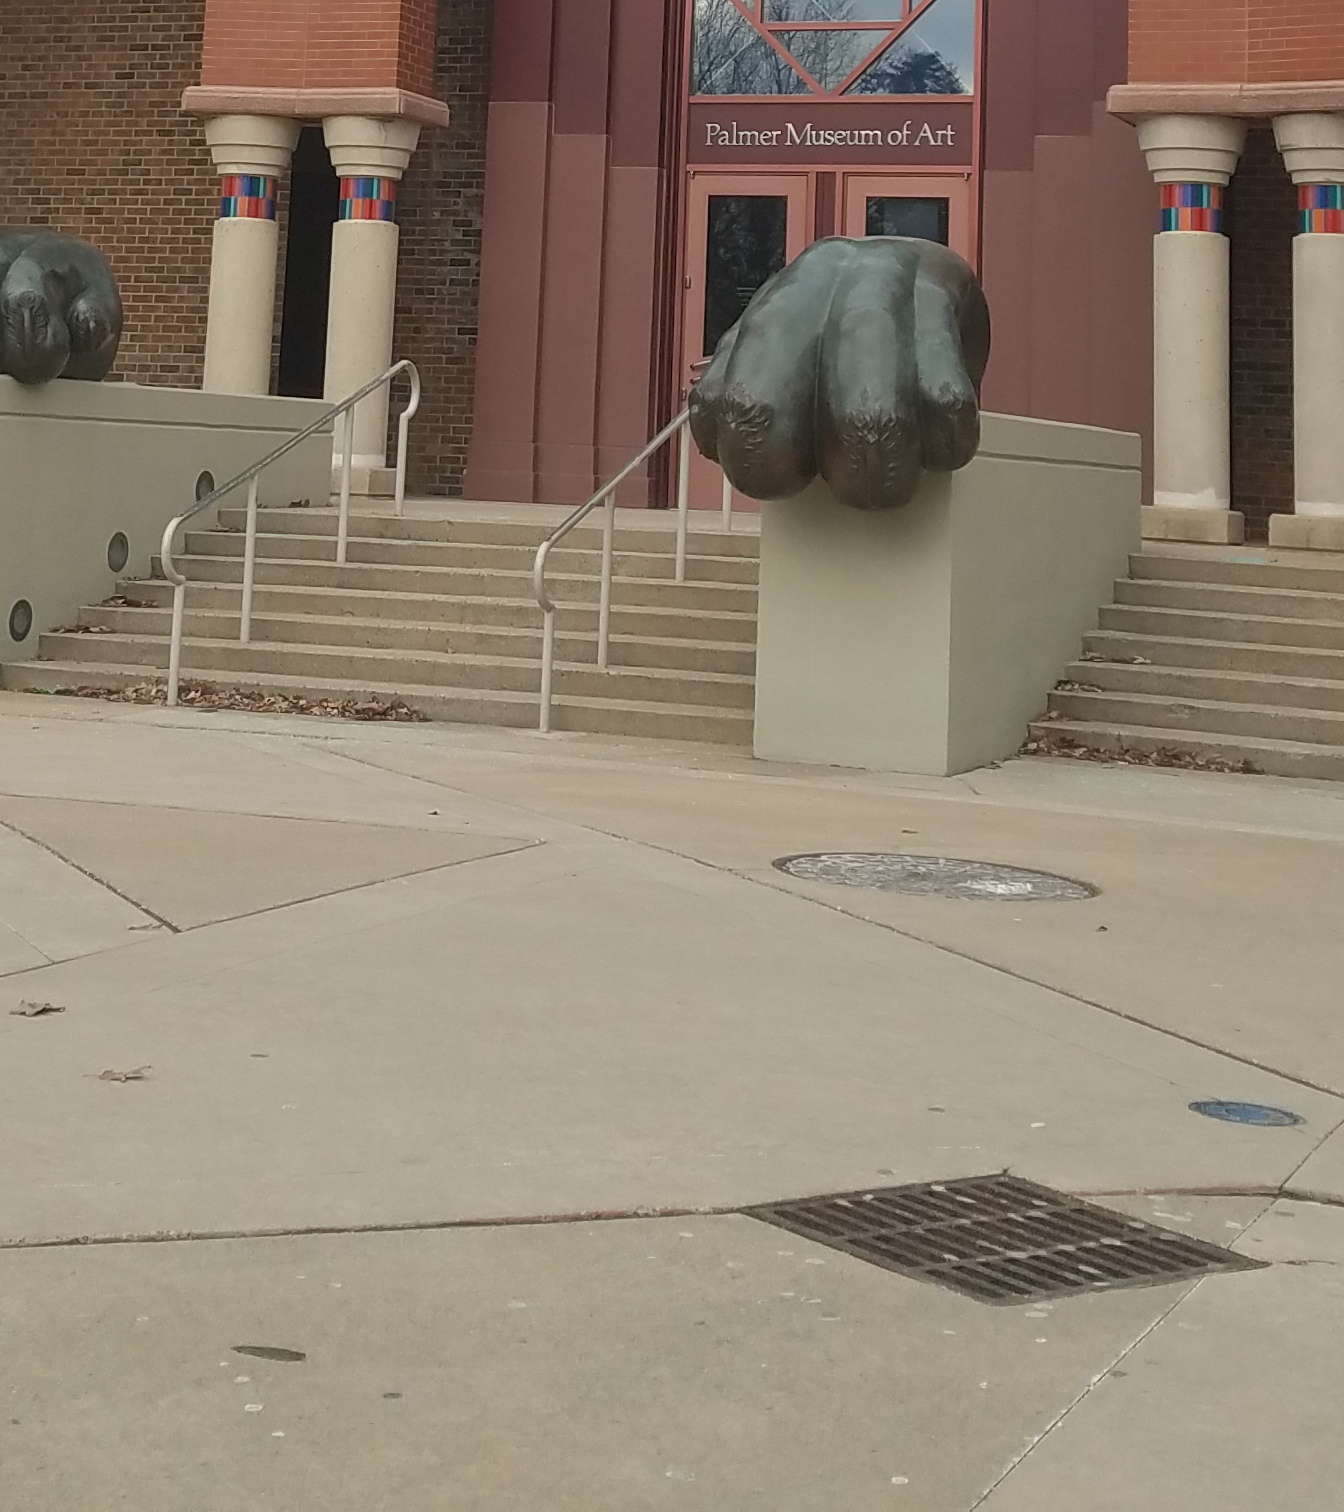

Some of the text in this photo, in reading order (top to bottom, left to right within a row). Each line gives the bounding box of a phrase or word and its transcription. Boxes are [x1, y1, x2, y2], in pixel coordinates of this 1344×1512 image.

[705, 120, 956, 146] Palmer Museum of Art
